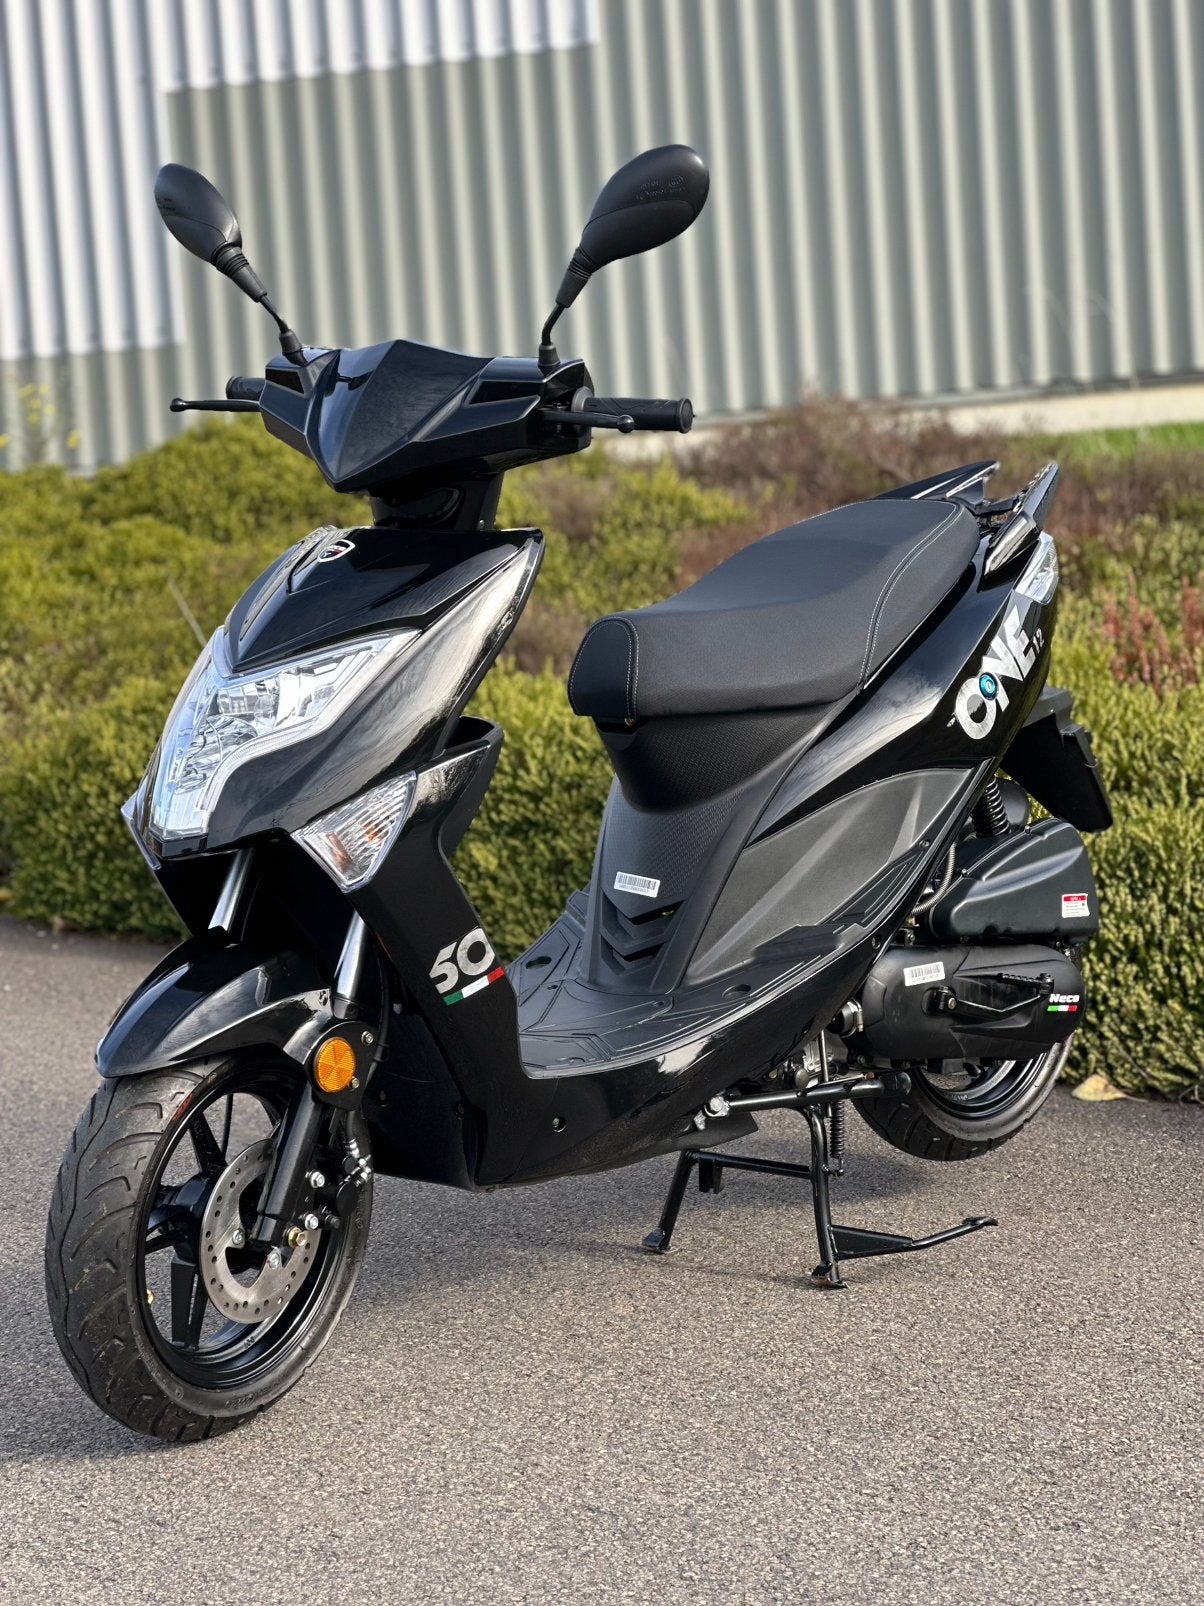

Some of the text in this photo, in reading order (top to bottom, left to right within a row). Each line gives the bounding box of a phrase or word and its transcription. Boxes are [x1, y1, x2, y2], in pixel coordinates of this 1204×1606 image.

[955, 604, 1037, 740] ONE
[429, 927, 496, 994] 50
[1049, 993, 1080, 1003] Neco
